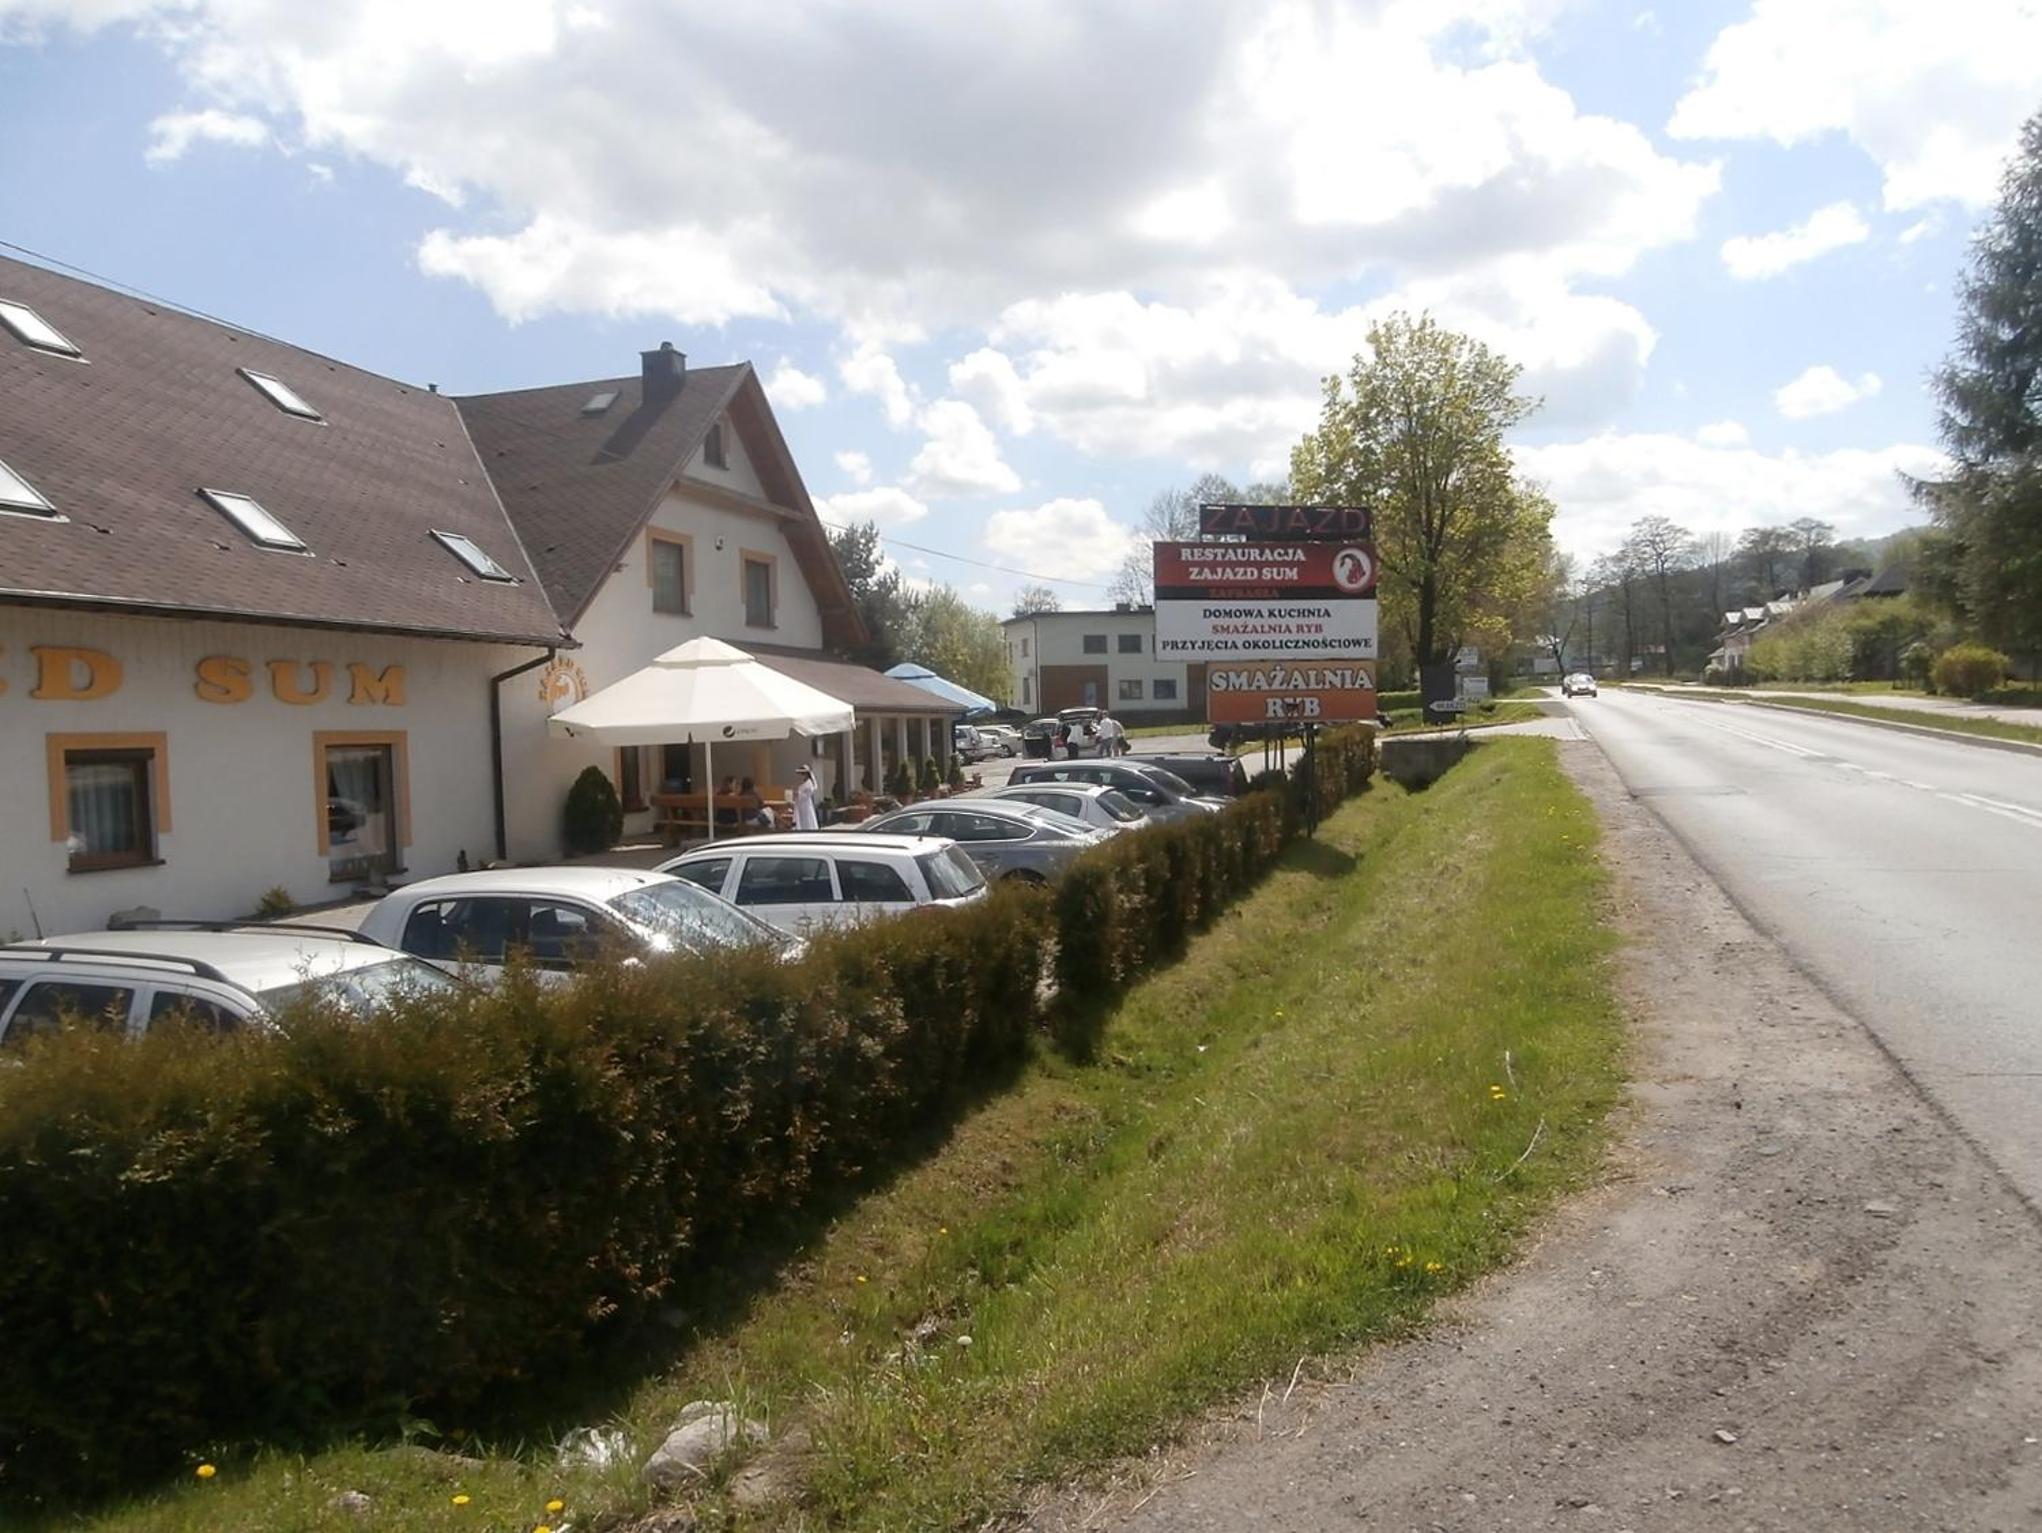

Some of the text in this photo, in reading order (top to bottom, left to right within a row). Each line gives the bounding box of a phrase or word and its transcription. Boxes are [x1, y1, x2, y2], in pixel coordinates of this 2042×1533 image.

[1205, 506, 1366, 533] ZAJAZD
[1181, 548, 1307, 562] RESTAURACJA
[1189, 567, 1299, 580] ZAJAZD SUM
[1203, 608, 1331, 619] DOMOWA KUCHNIA
[1211, 621, 1323, 635] SMAŻALNIA RYB
[1162, 639, 1239, 652] PRZYJĘCIA
[194, 655, 408, 705] SUM
[1210, 665, 1373, 691] SMAŻALNIA
